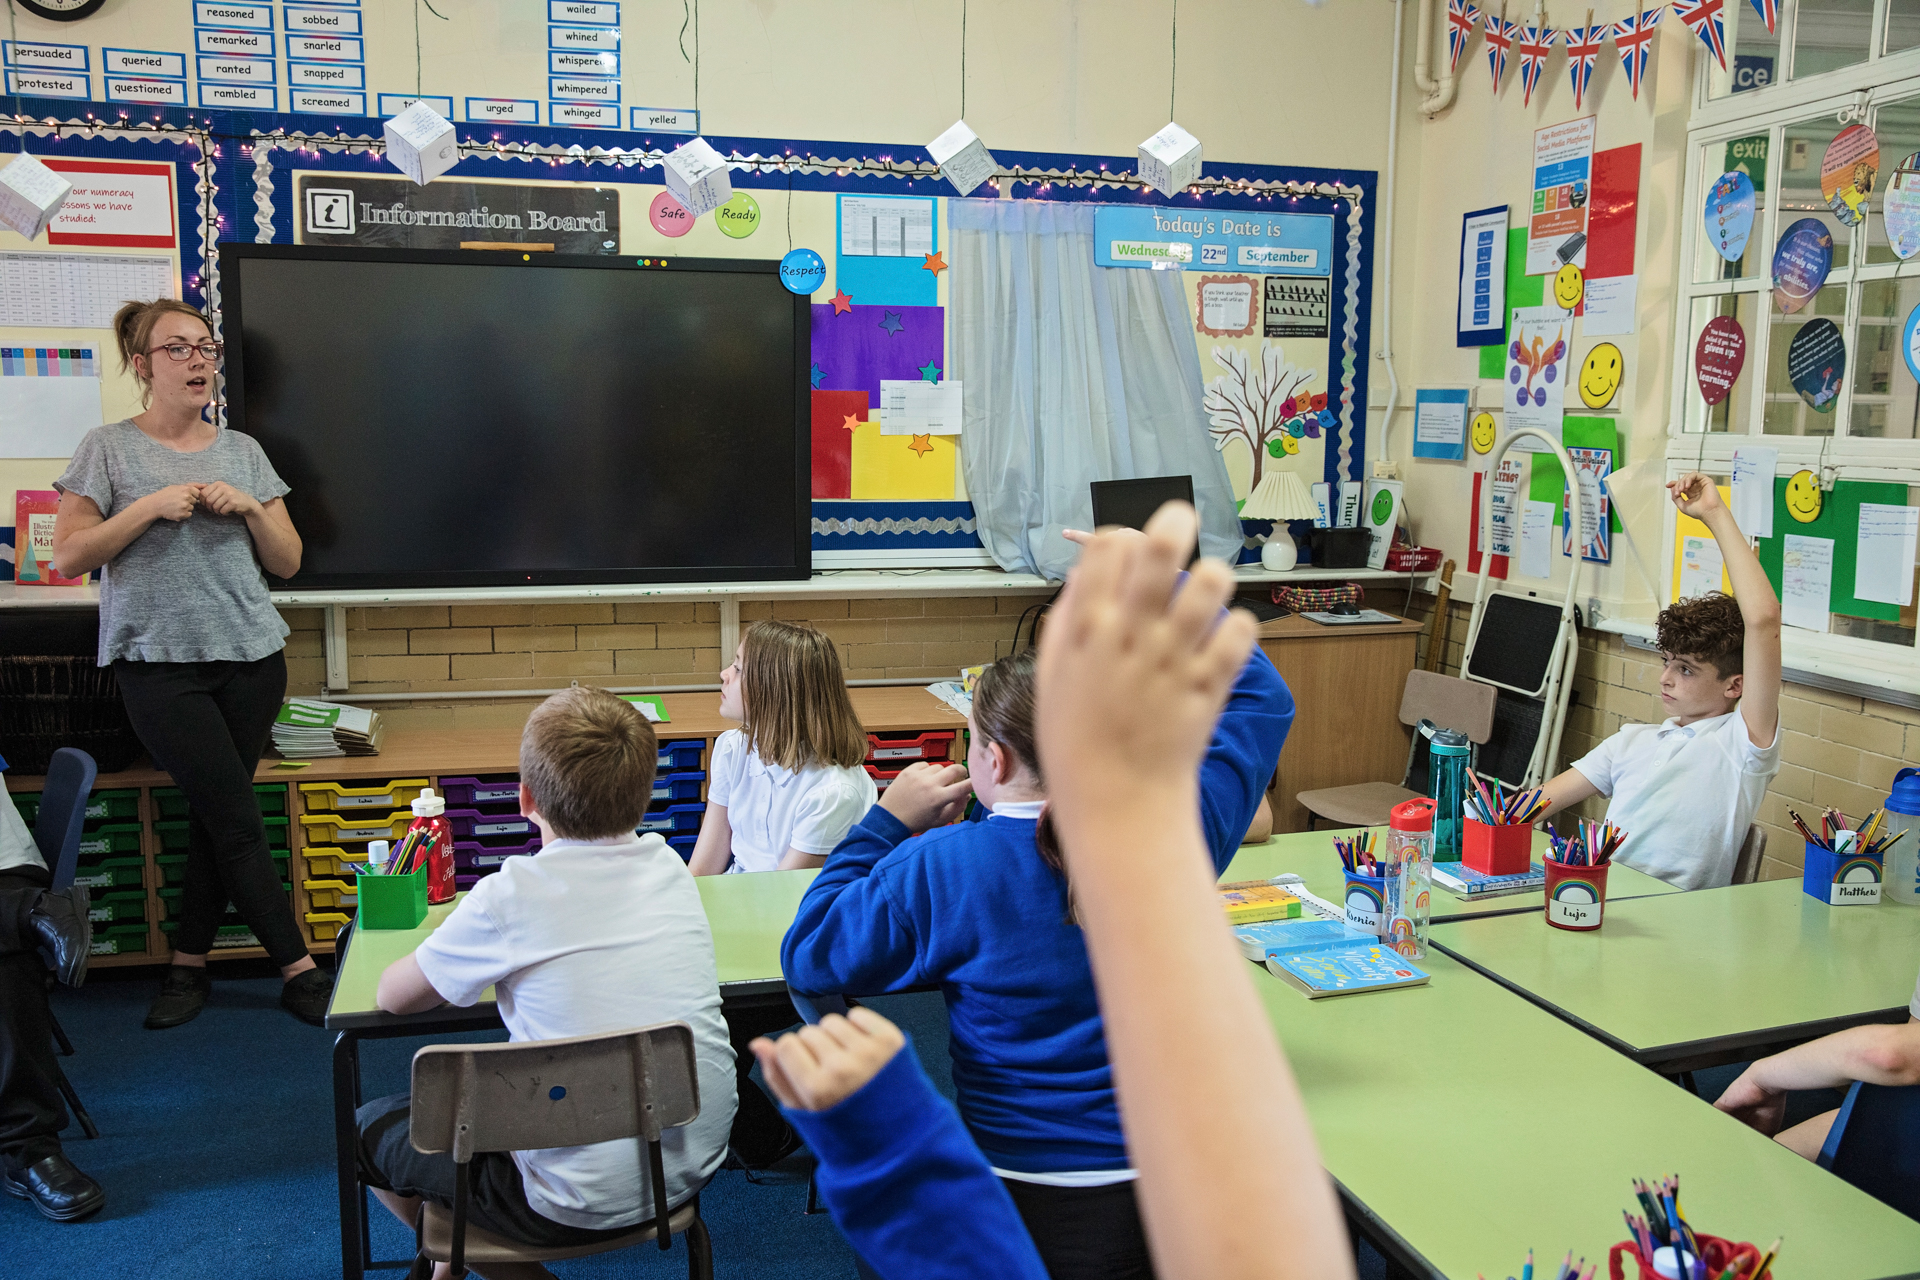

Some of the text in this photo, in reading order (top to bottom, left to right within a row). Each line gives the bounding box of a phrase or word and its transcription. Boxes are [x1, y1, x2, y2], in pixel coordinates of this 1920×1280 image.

[206, 8, 254, 19] reasoned
[566, 6, 596, 15] wailed
[302, 15, 339, 26] sobbed
[207, 35, 258, 46] remarked
[565, 33, 598, 42] whined
[303, 41, 341, 51] snarled
[14, 48, 72, 59] persuaded
[121, 56, 162, 67] queried
[558, 56, 605, 67] whispere
[216, 65, 251, 75] ranted
[303, 69, 344, 80] snapped
[18, 79, 73, 90] protested
[115, 83, 172, 95] questioned
[557, 84, 608, 95] whimpered
[214, 89, 256, 99] rambled
[301, 97, 350, 108] screamed
[486, 104, 513, 115] urged
[563, 108, 601, 119] whinged
[649, 115, 677, 125] yelled
[1551, 126, 1579, 138] Restrictions
[1537, 135, 1591, 153] Social Media Platforms
[1733, 139, 1767, 159] exit
[72, 188, 134, 199] our numeracy
[61, 201, 91, 210] essons
[109, 201, 133, 211] have
[59, 213, 97, 224] studied:
[359, 202, 523, 230] Information
[527, 210, 609, 232] Board
[659, 207, 686, 220] Safe
[721, 208, 757, 223] Ready
[1152, 215, 1282, 239] Today's Date is
[1202, 248, 1227, 260] 22nd
[1246, 250, 1310, 263] September
[1781, 251, 1818, 274] we truly are,
[780, 265, 826, 278] Respect
[1783, 273, 1810, 291] abilities.
[1704, 342, 1737, 360] given up.
[1699, 370, 1731, 390] learning.
[1587, 457, 1607, 465] Values
[34, 537, 53, 547] Mat
[1839, 887, 1877, 897] Matthew
[1346, 908, 1377, 926] Ksenia
[1563, 906, 1588, 922] Luja
